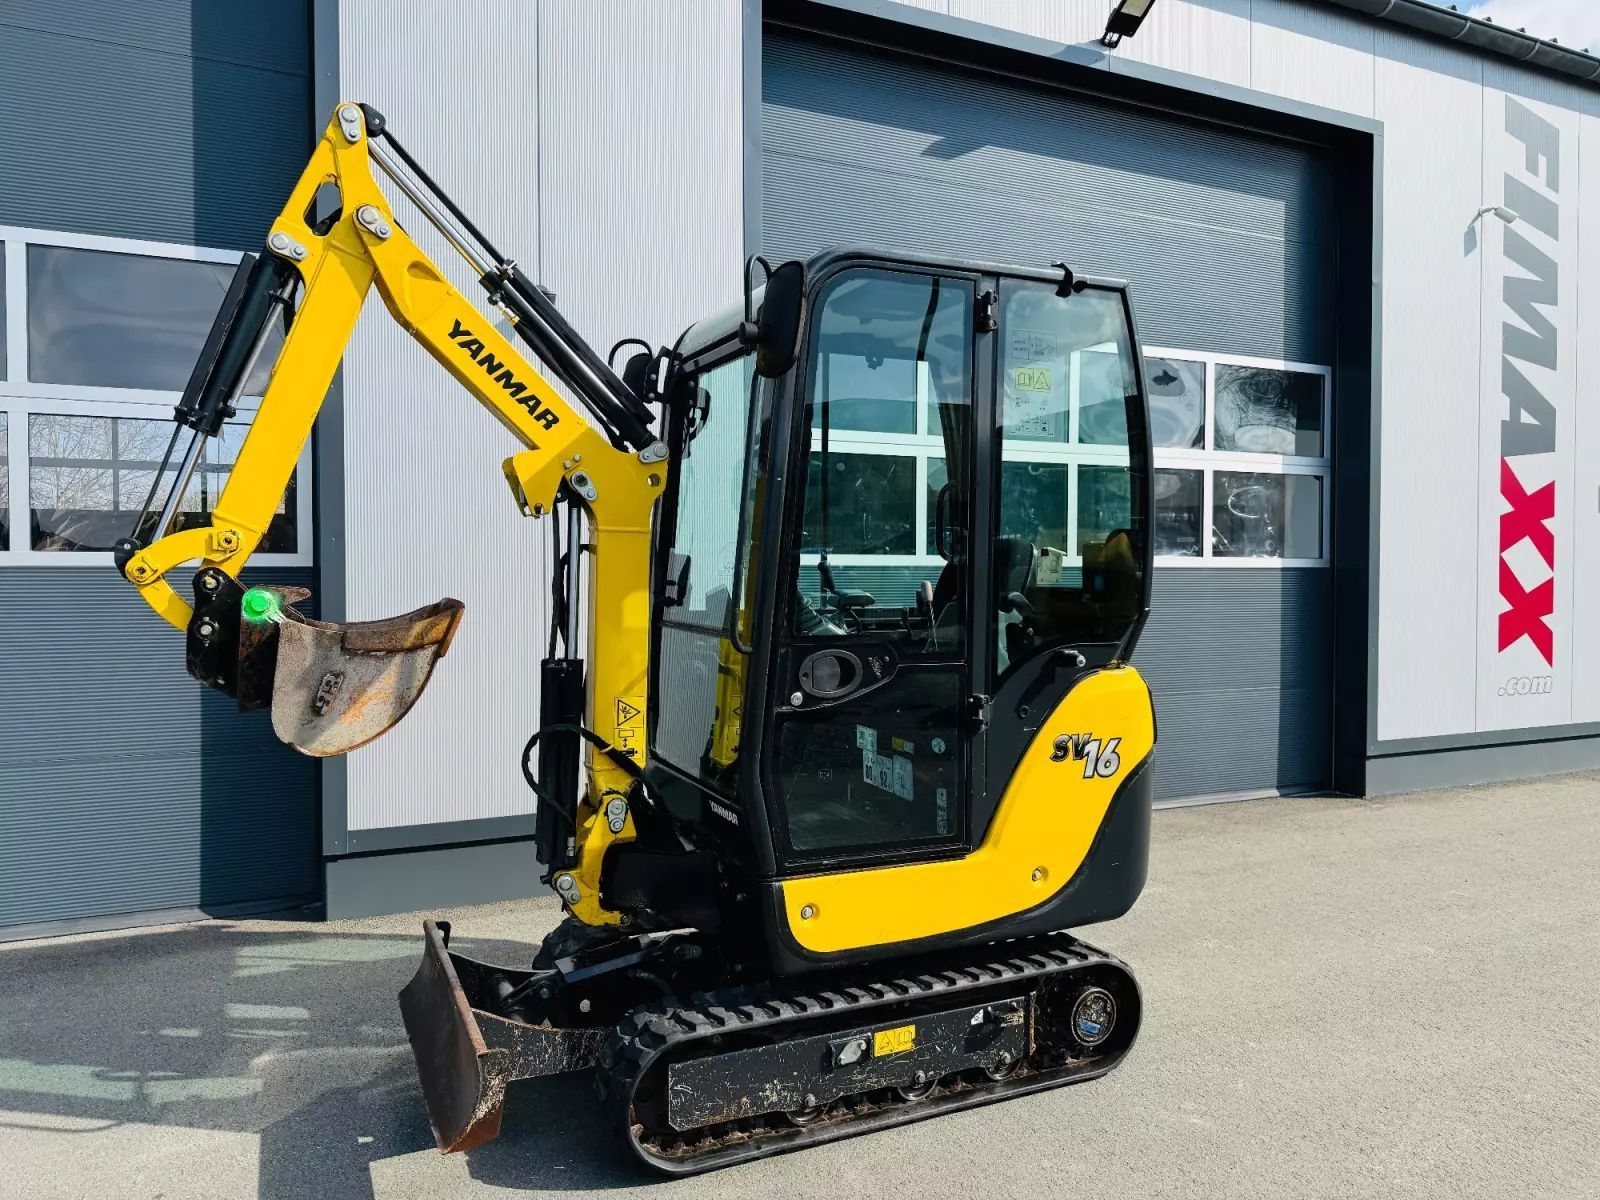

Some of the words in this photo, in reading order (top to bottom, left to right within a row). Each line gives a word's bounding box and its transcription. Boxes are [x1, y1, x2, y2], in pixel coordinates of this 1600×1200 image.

[447, 318, 560, 431] YANMAR
[1498, 94, 1560, 669] FIMAXX
[1497, 676, 1553, 697] .com
